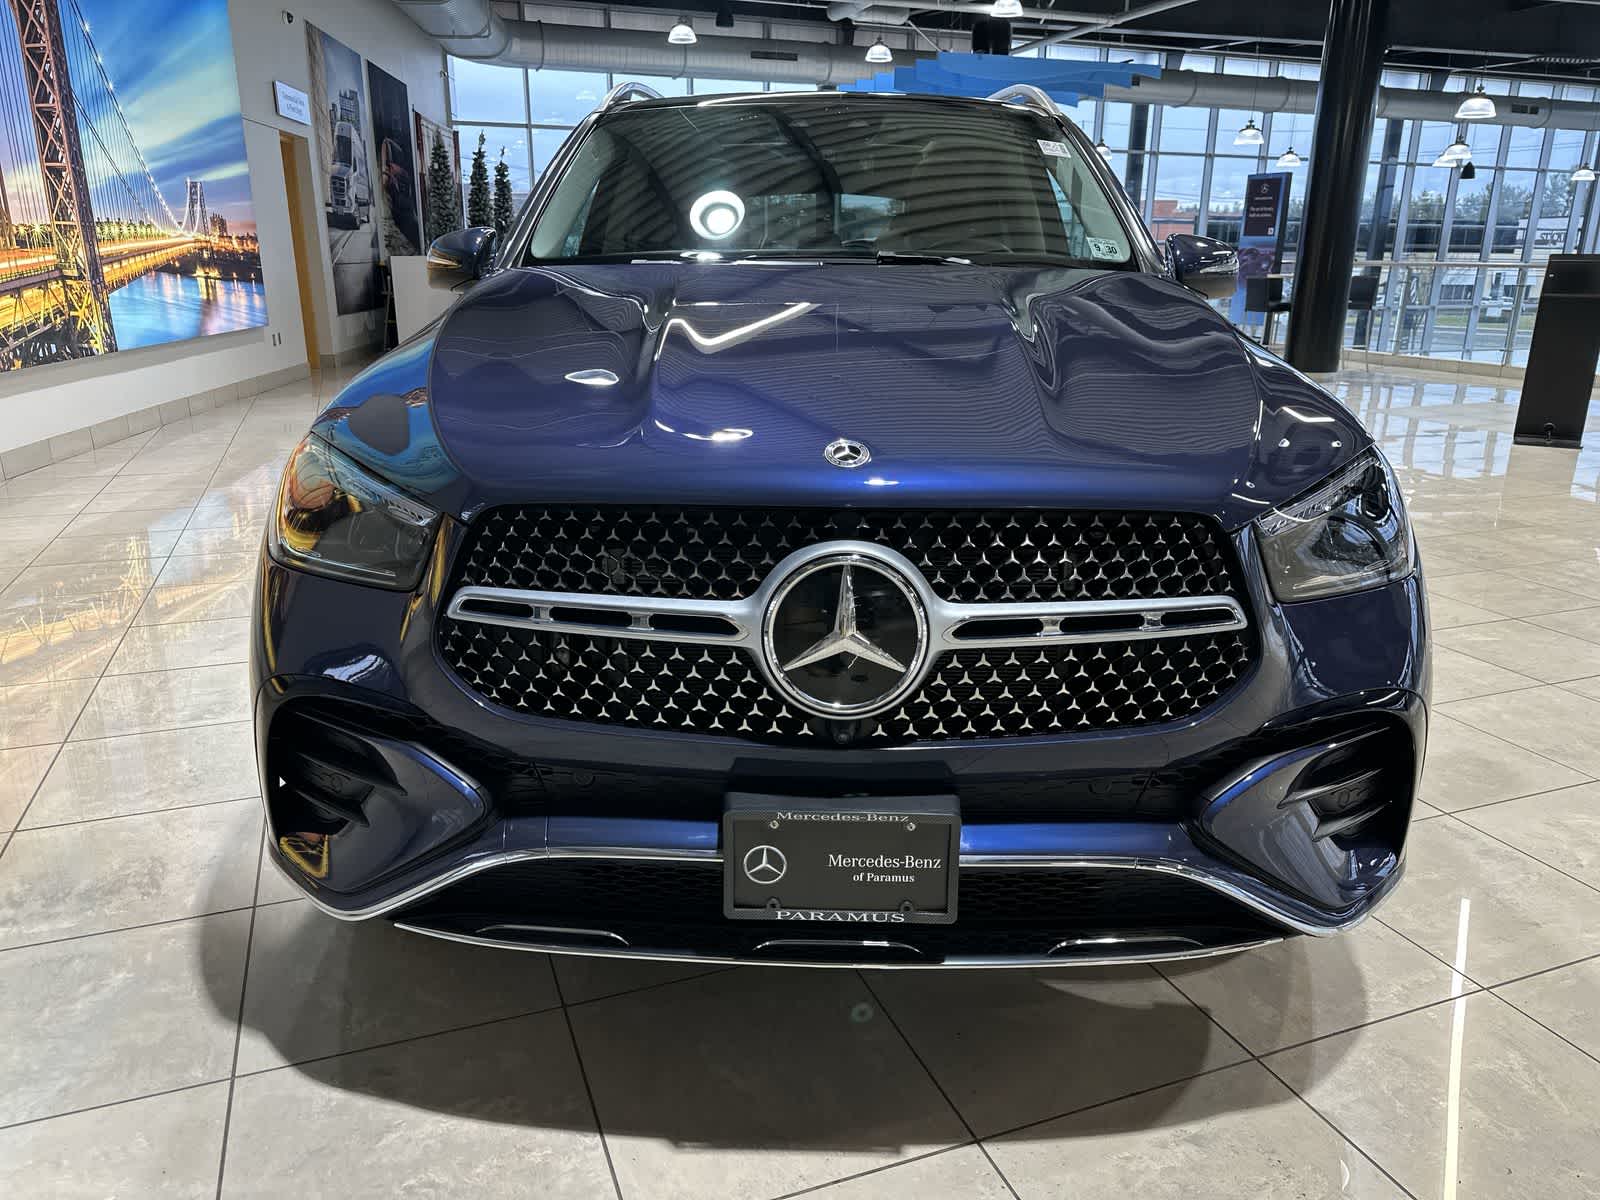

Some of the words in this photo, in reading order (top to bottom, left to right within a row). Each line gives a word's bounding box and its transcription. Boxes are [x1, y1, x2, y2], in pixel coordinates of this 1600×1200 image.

[1094, 243, 1101, 252] 9
[1105, 245, 1118, 255] 30
[777, 811, 909, 823] Mercedes-Benz
[828, 854, 942, 869] Mercedes-Benz
[853, 872, 864, 882] of
[867, 872, 914, 883] Paramus
[776, 911, 905, 923] PARAMUS
